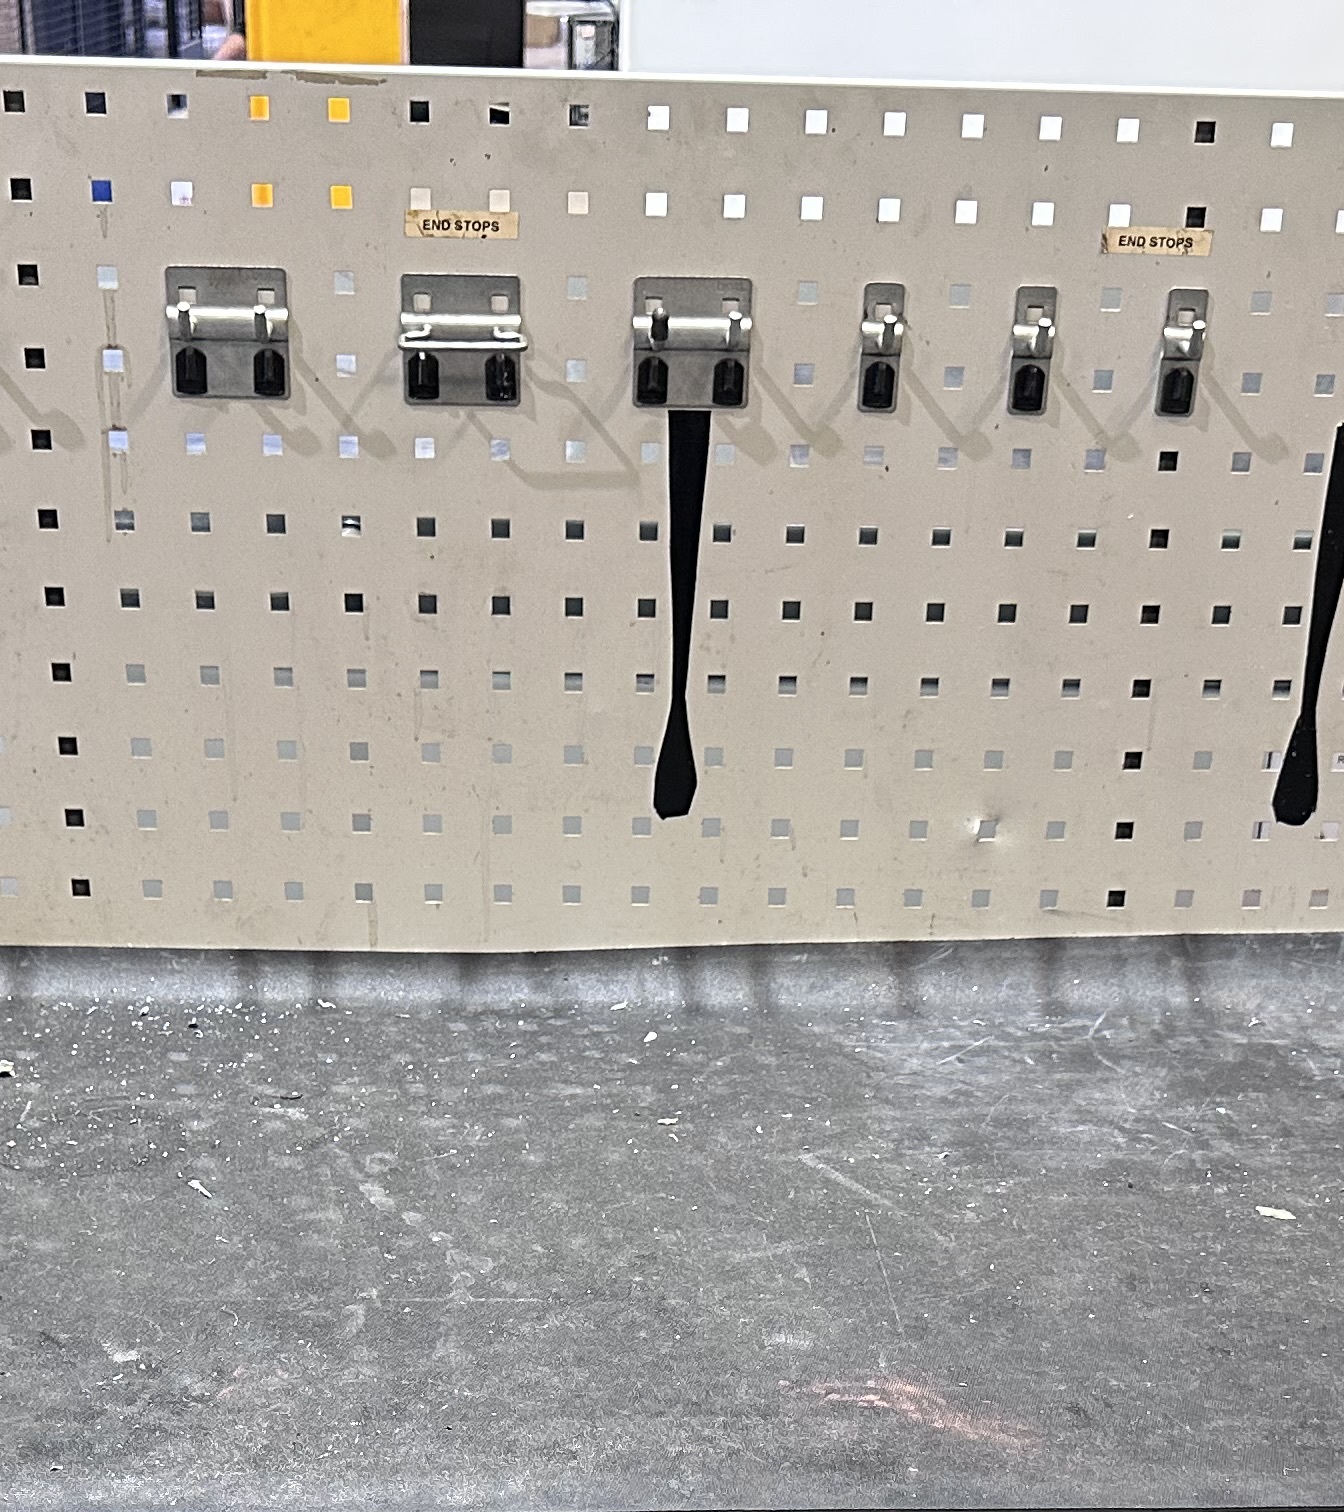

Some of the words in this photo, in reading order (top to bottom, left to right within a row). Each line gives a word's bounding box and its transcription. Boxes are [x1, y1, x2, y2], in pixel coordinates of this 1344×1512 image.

[422, 220, 451, 231] END
[454, 220, 500, 232] STOPS
[1119, 236, 1146, 247] END
[1149, 236, 1194, 248] STOPS
